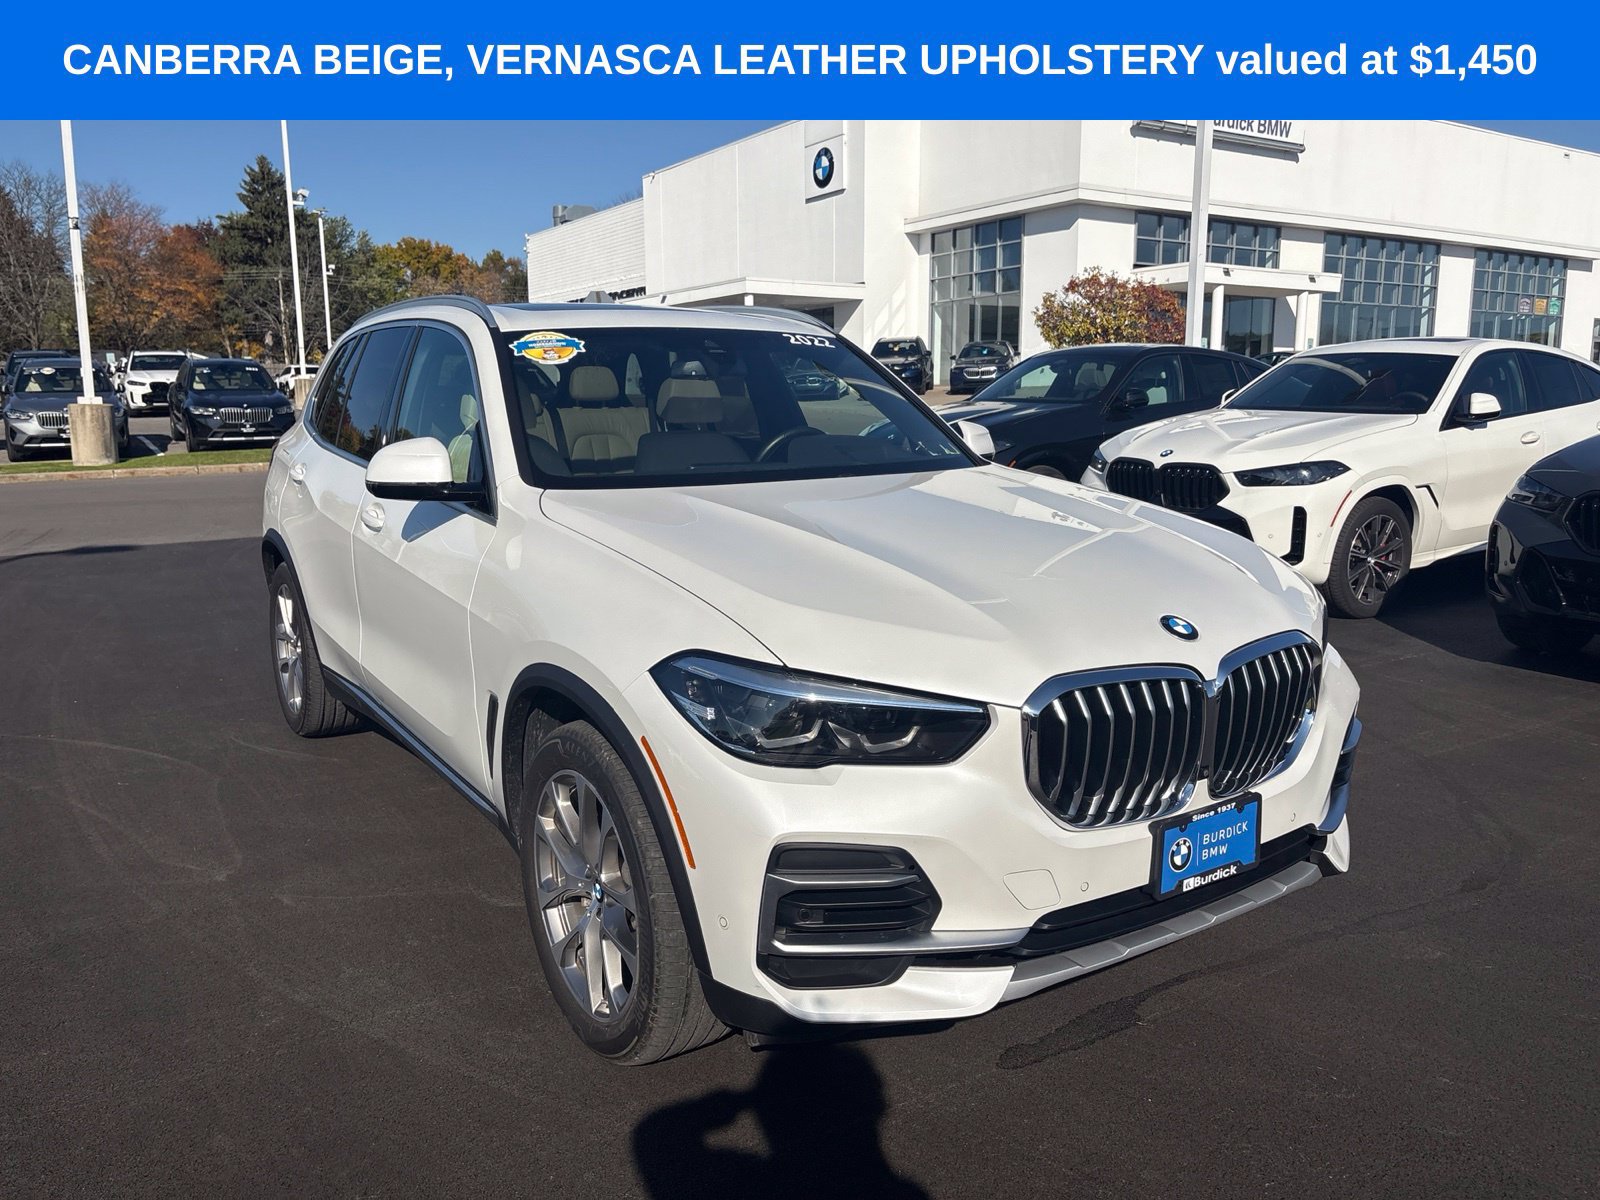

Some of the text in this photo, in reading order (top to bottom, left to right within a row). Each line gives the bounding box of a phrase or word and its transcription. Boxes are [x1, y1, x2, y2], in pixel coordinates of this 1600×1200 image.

[1257, 119, 1292, 138] BMW
[782, 333, 836, 348] 2022
[1192, 802, 1237, 822] Since 1937
[1202, 821, 1248, 845] BURDICK
[1202, 844, 1228, 861] BMW
[1194, 865, 1237, 887] Burdick
